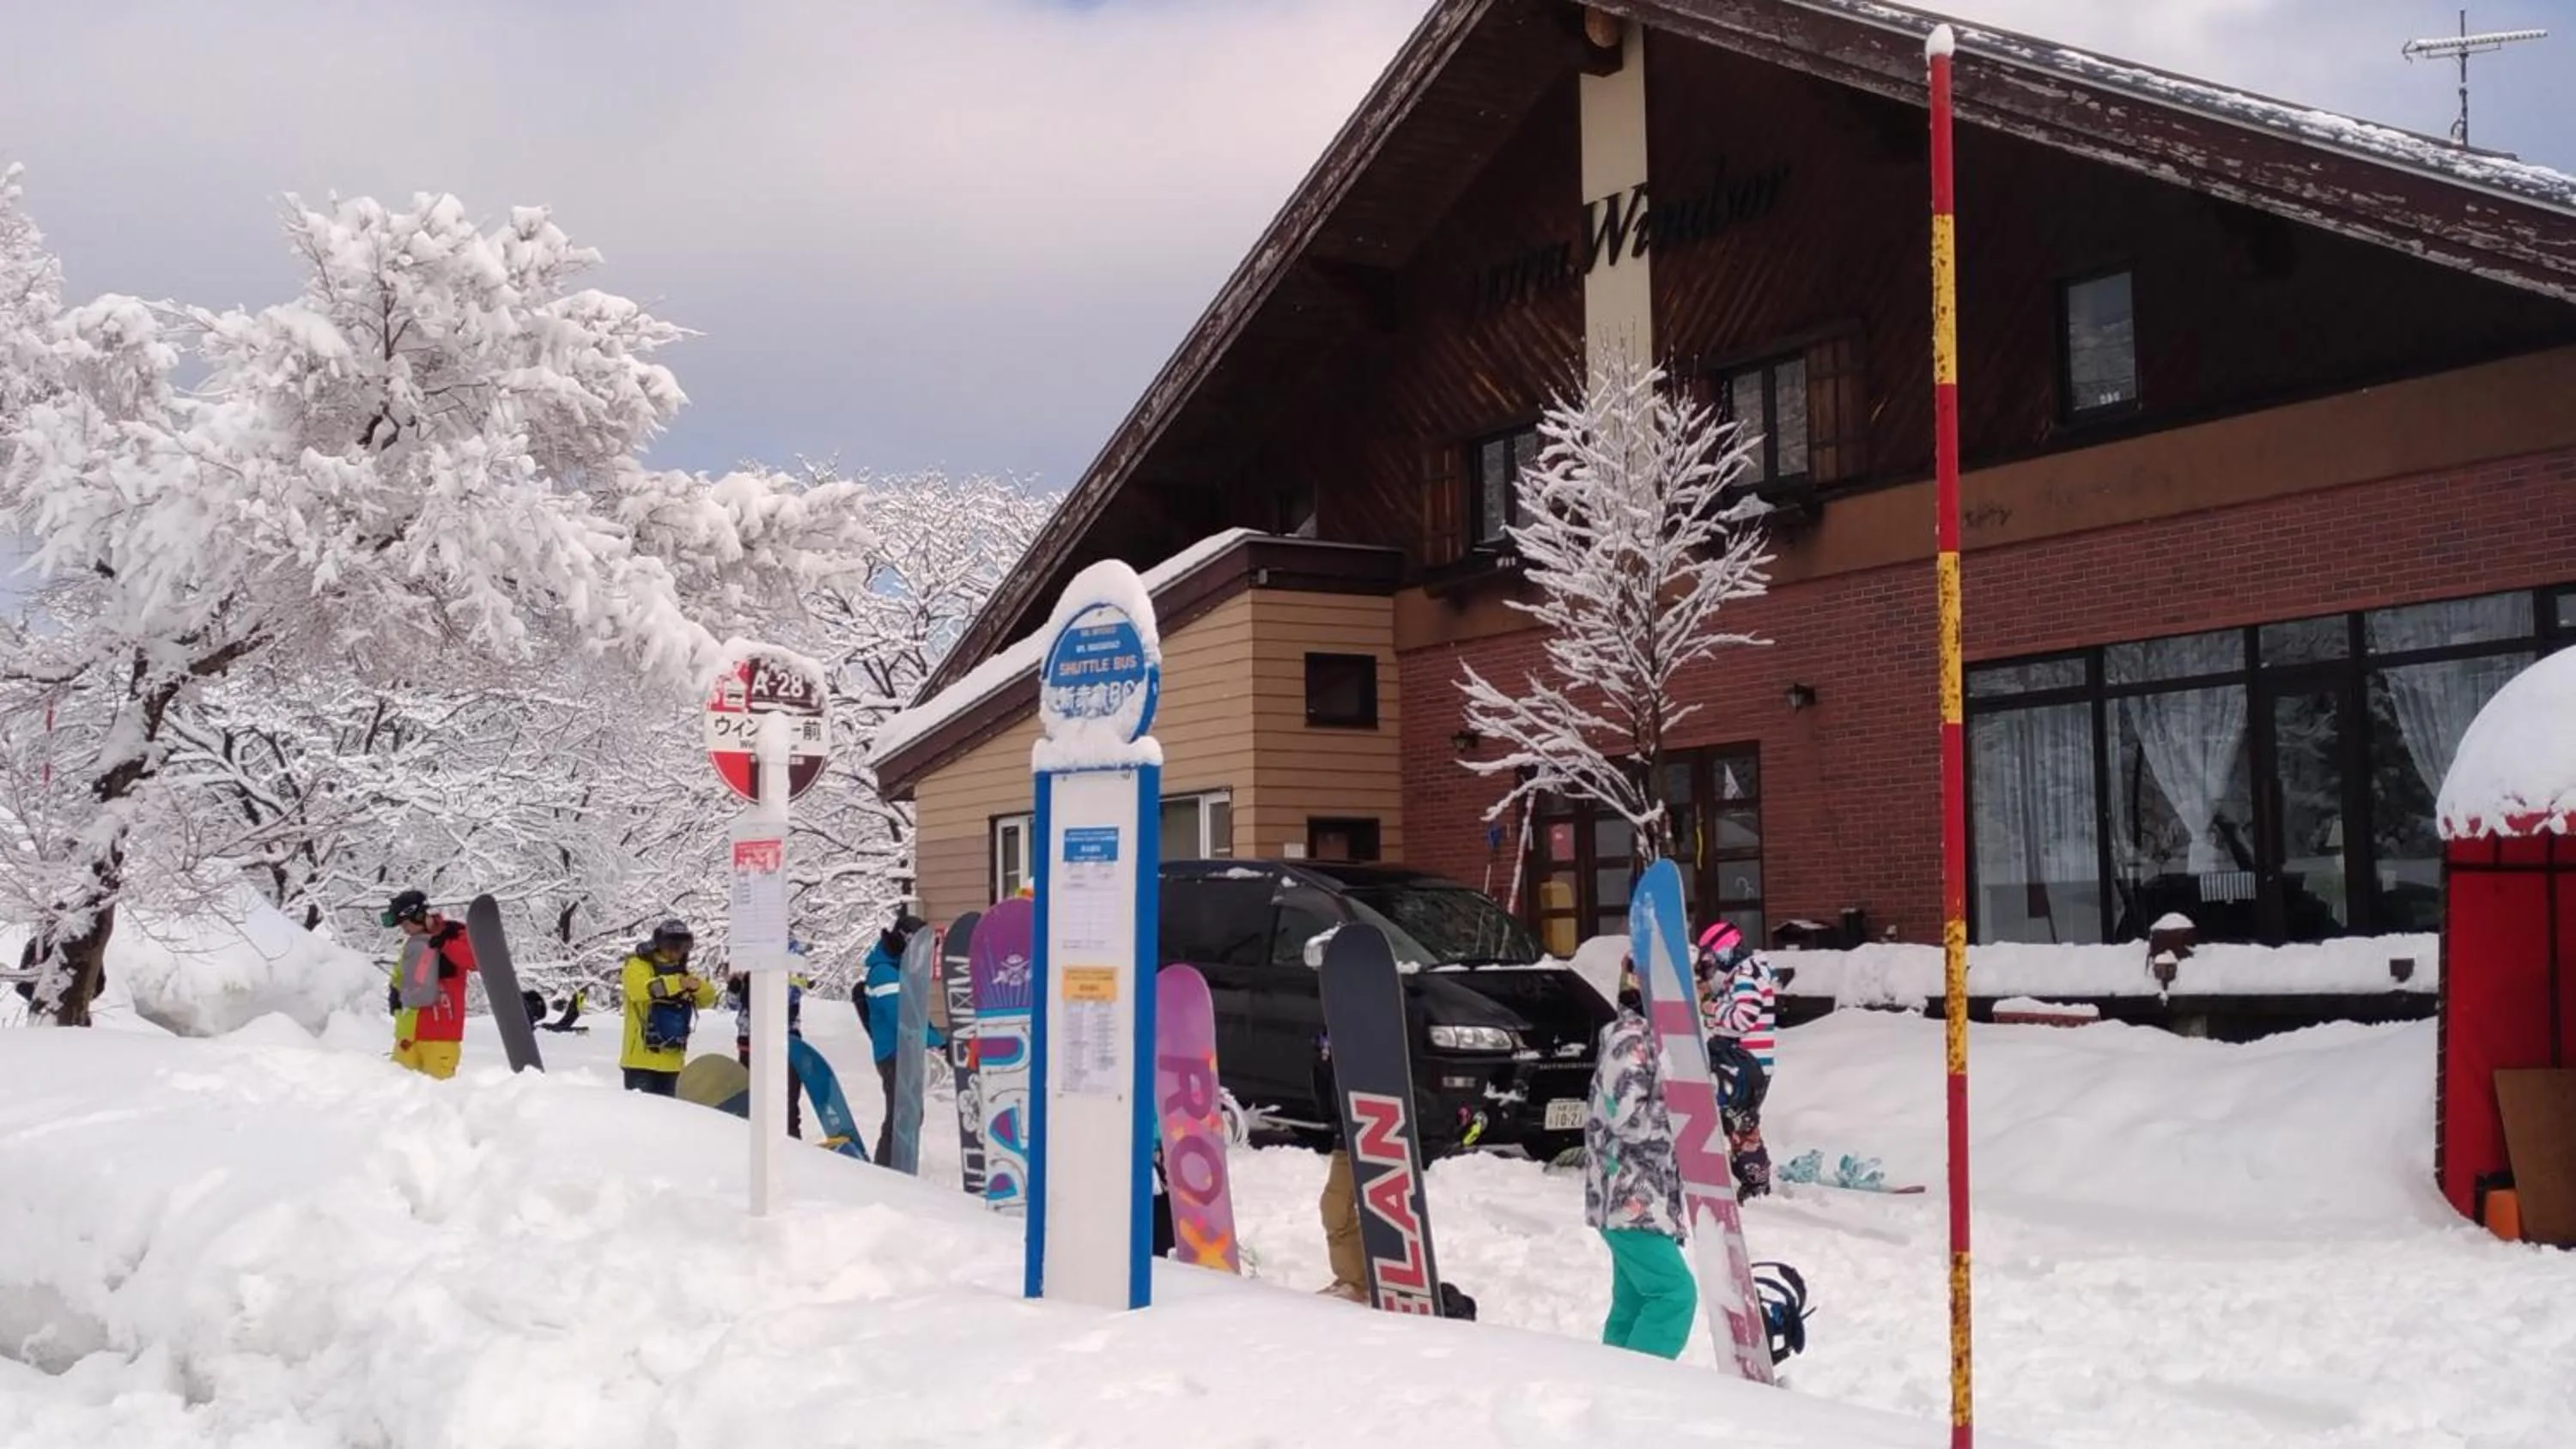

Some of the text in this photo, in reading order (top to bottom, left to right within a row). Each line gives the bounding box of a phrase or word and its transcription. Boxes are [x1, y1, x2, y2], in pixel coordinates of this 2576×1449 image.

[1059, 654, 1138, 676] SHUTTLE BUS
[751, 670, 805, 697] A-28
